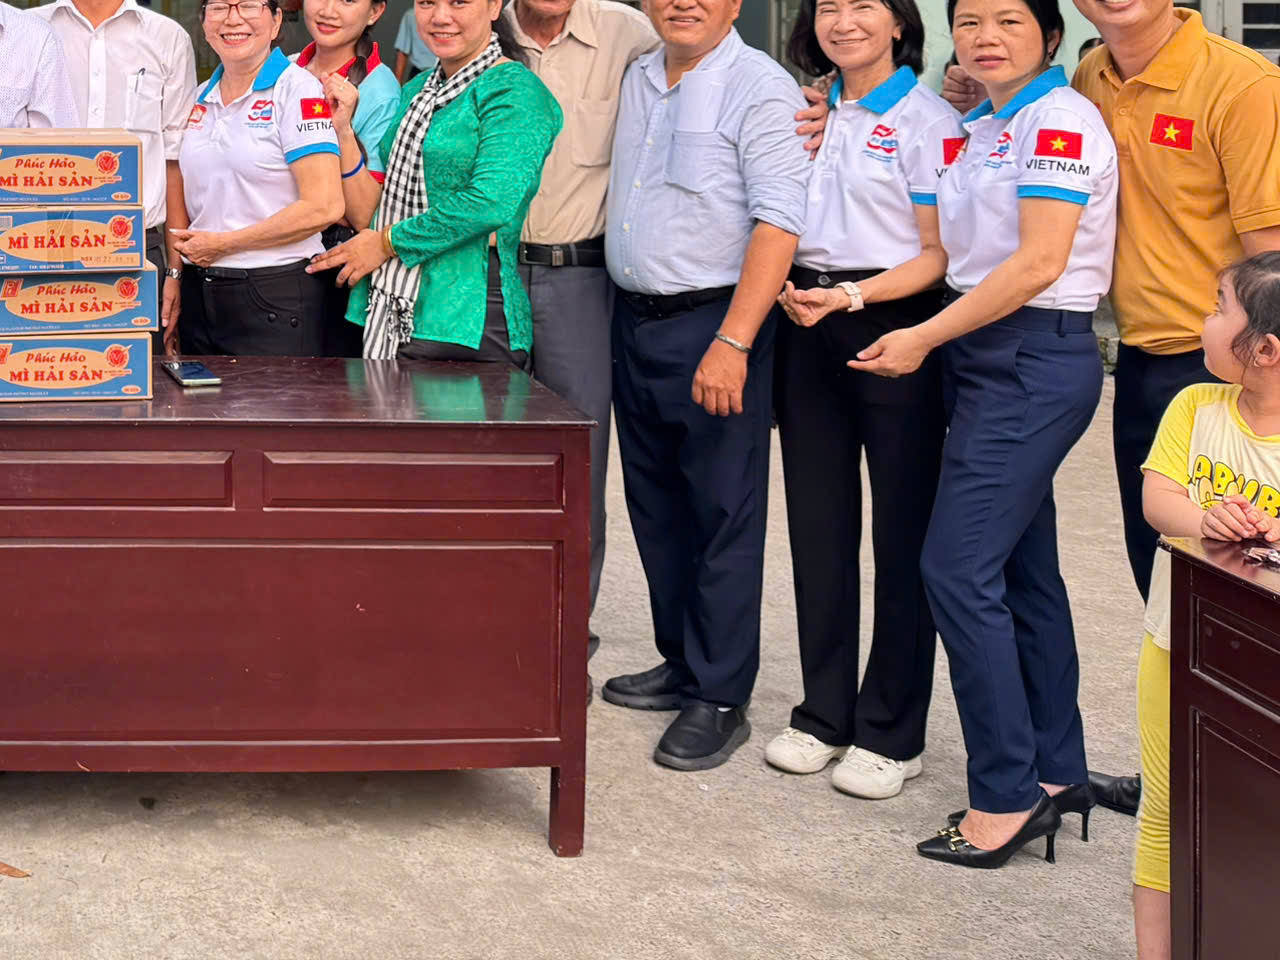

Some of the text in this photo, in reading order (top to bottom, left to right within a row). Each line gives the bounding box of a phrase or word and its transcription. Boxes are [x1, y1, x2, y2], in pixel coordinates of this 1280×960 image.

[296, 120, 334, 133] VIETNA
[14, 156, 76, 169] Phúc Hảo
[1025, 158, 1091, 177] VIETNAM
[23, 171, 53, 187] HẢI
[58, 171, 93, 187] SẢN
[7, 229, 106, 249] MÌ HẢI SẢN
[36, 283, 97, 296] Phúc Hảo
[20, 297, 113, 314] MÌ HẢI SẢN
[25, 351, 86, 363] Phúc Hảo
[9, 365, 103, 382] MÌ HẢI SẢN
